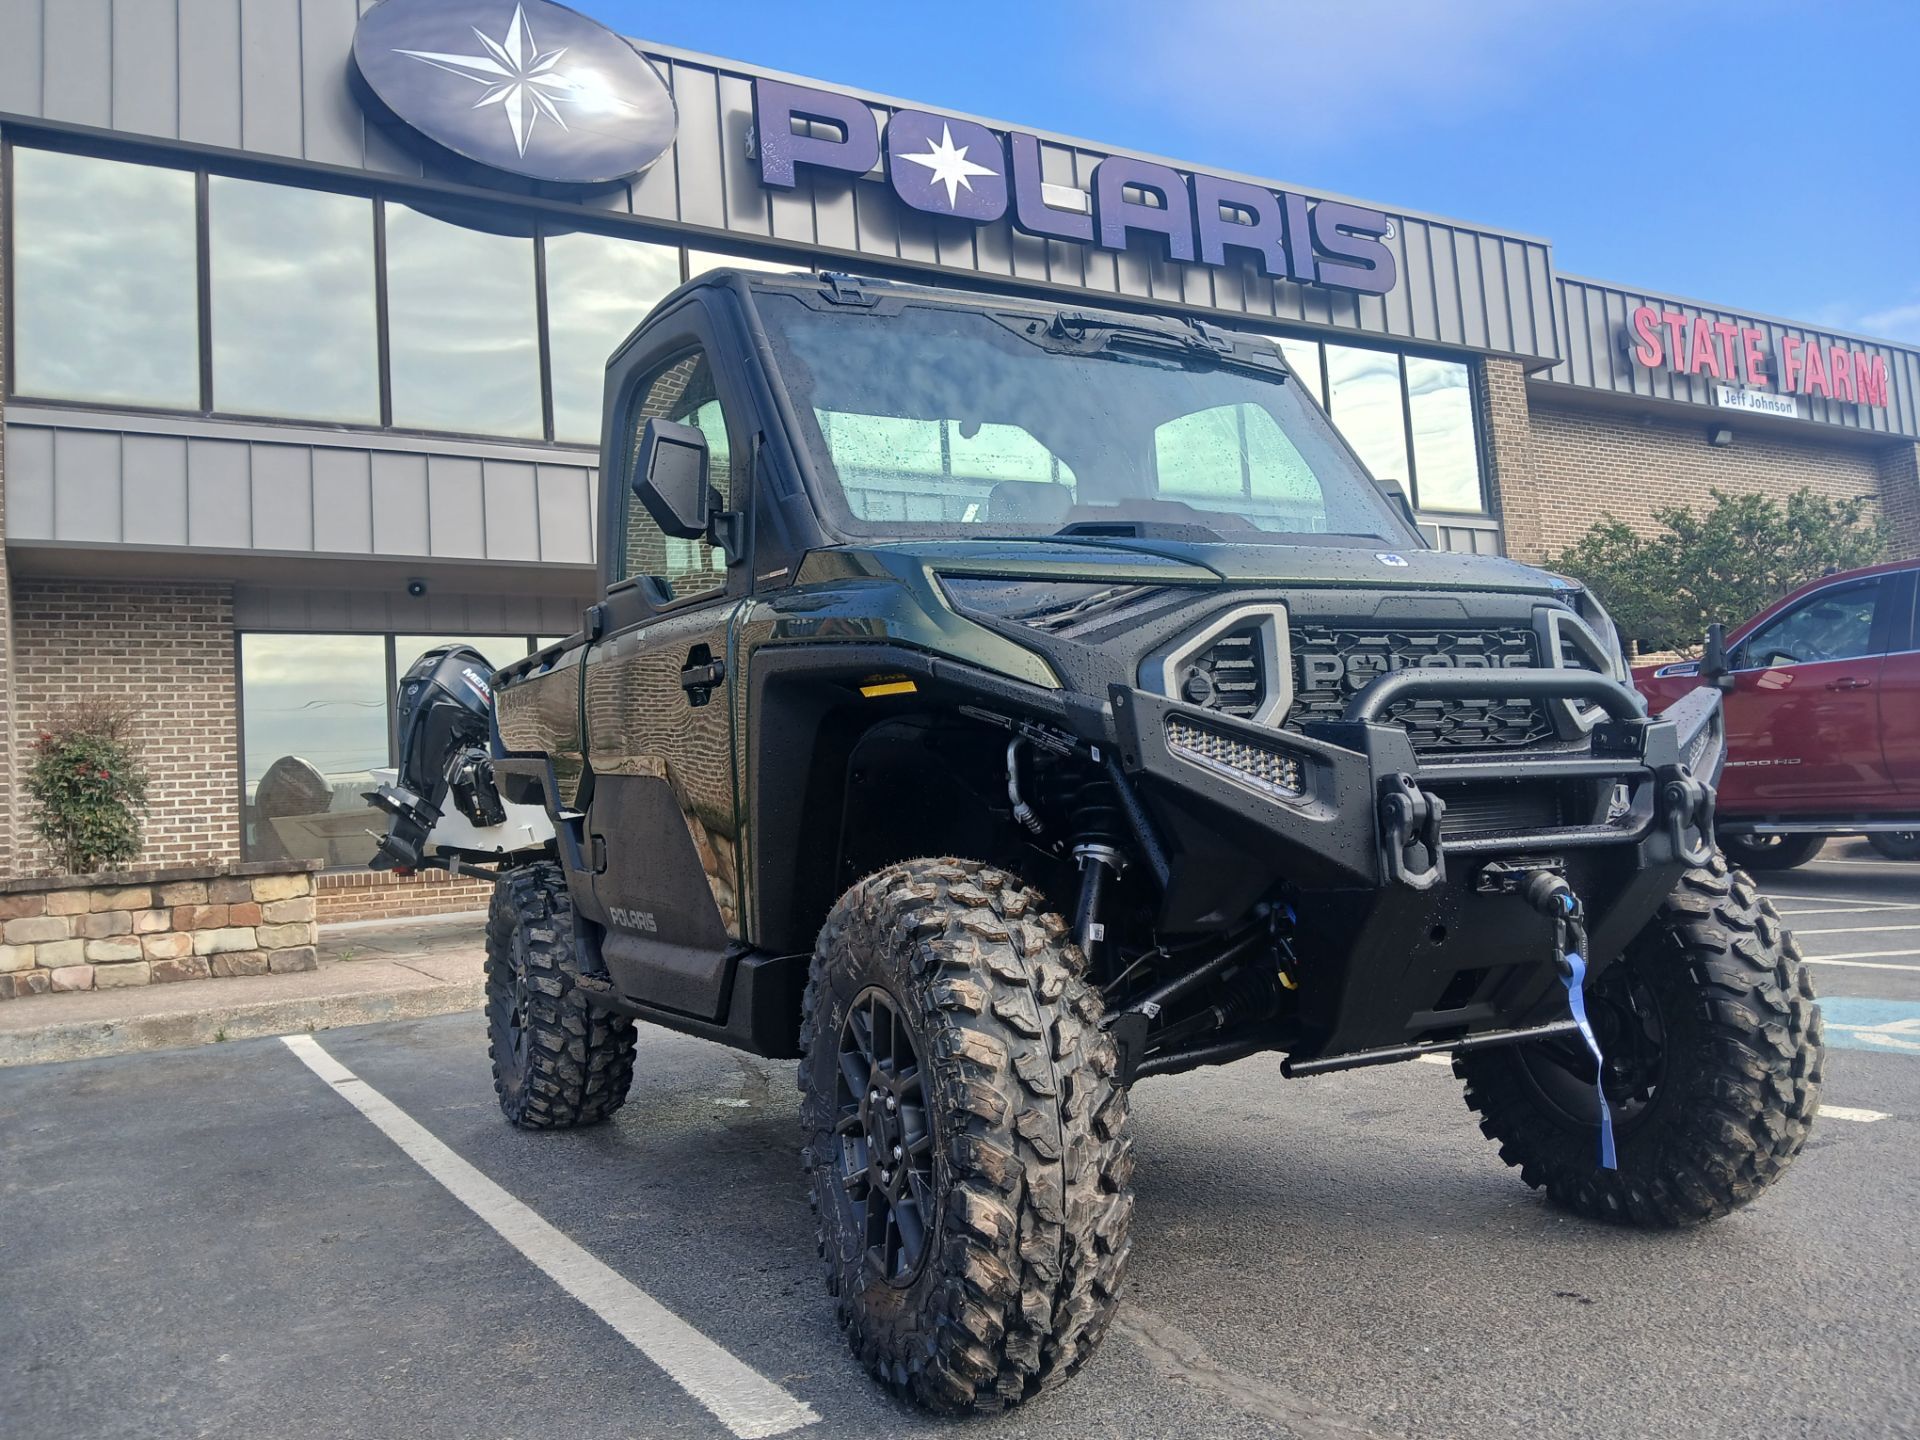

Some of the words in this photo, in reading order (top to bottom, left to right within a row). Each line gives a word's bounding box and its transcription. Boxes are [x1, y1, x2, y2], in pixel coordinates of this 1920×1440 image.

[752, 77, 1397, 296] POLARIS
[1632, 306, 1768, 385] STATE
[1781, 335, 1888, 408] FARM
[1724, 389, 1746, 406] Jeff
[1748, 394, 1793, 414] Johnson
[609, 906, 657, 933] POLARIS
